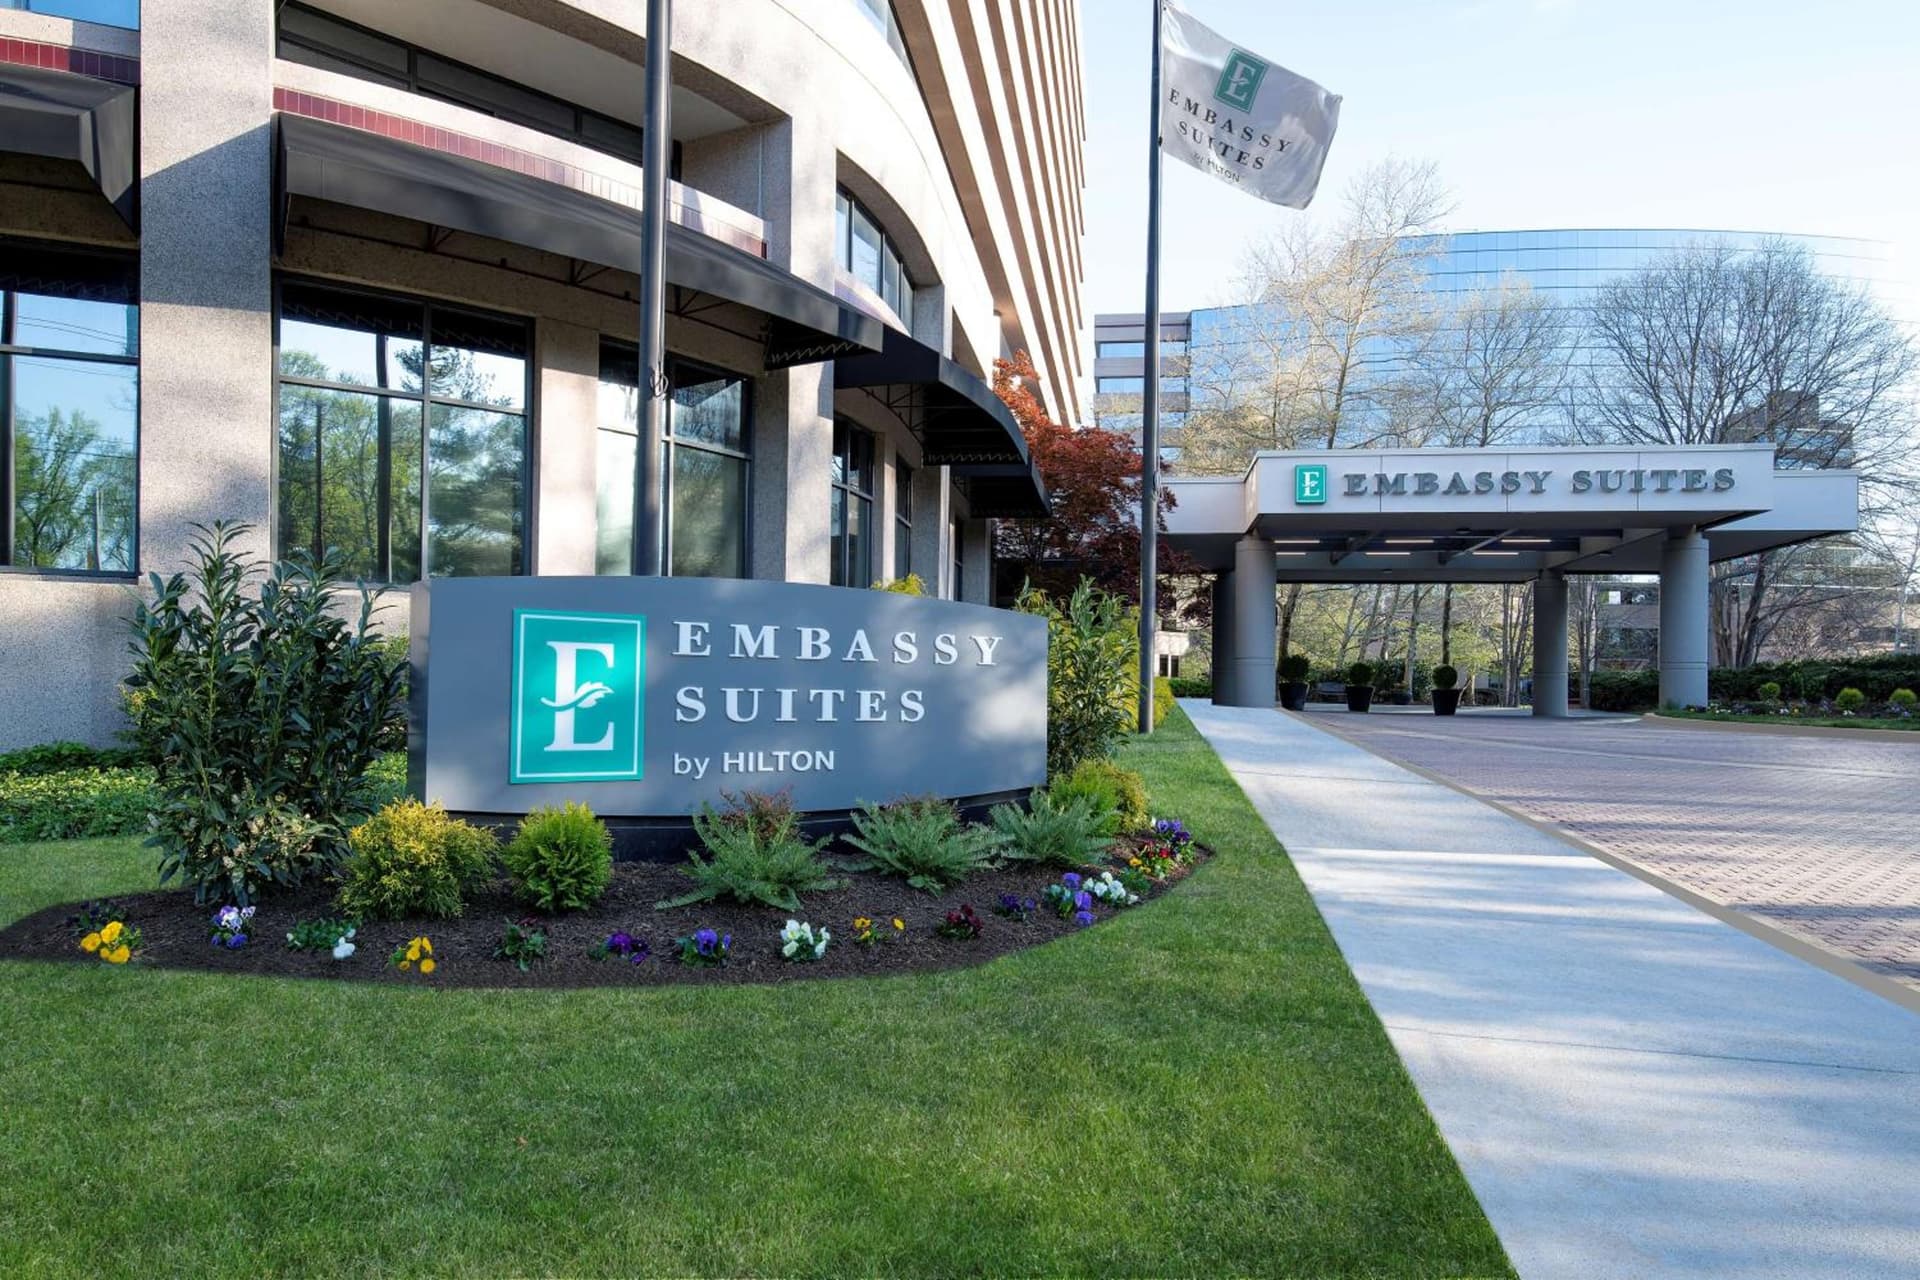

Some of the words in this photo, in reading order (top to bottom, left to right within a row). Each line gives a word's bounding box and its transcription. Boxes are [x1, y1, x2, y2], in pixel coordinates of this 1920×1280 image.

[1225, 59, 1256, 102] E
[1168, 88, 1291, 152] EMBASSY
[1178, 120, 1265, 170] SUITES
[1301, 471, 1320, 497] E
[1342, 469, 1553, 496] EMBASSY
[1571, 467, 1736, 494] SUITES
[672, 620, 1003, 666] EMBASSY
[540, 640, 615, 753] E
[675, 686, 926, 723] SUITES
[673, 752, 709, 780] by
[722, 750, 835, 774] HILTON
